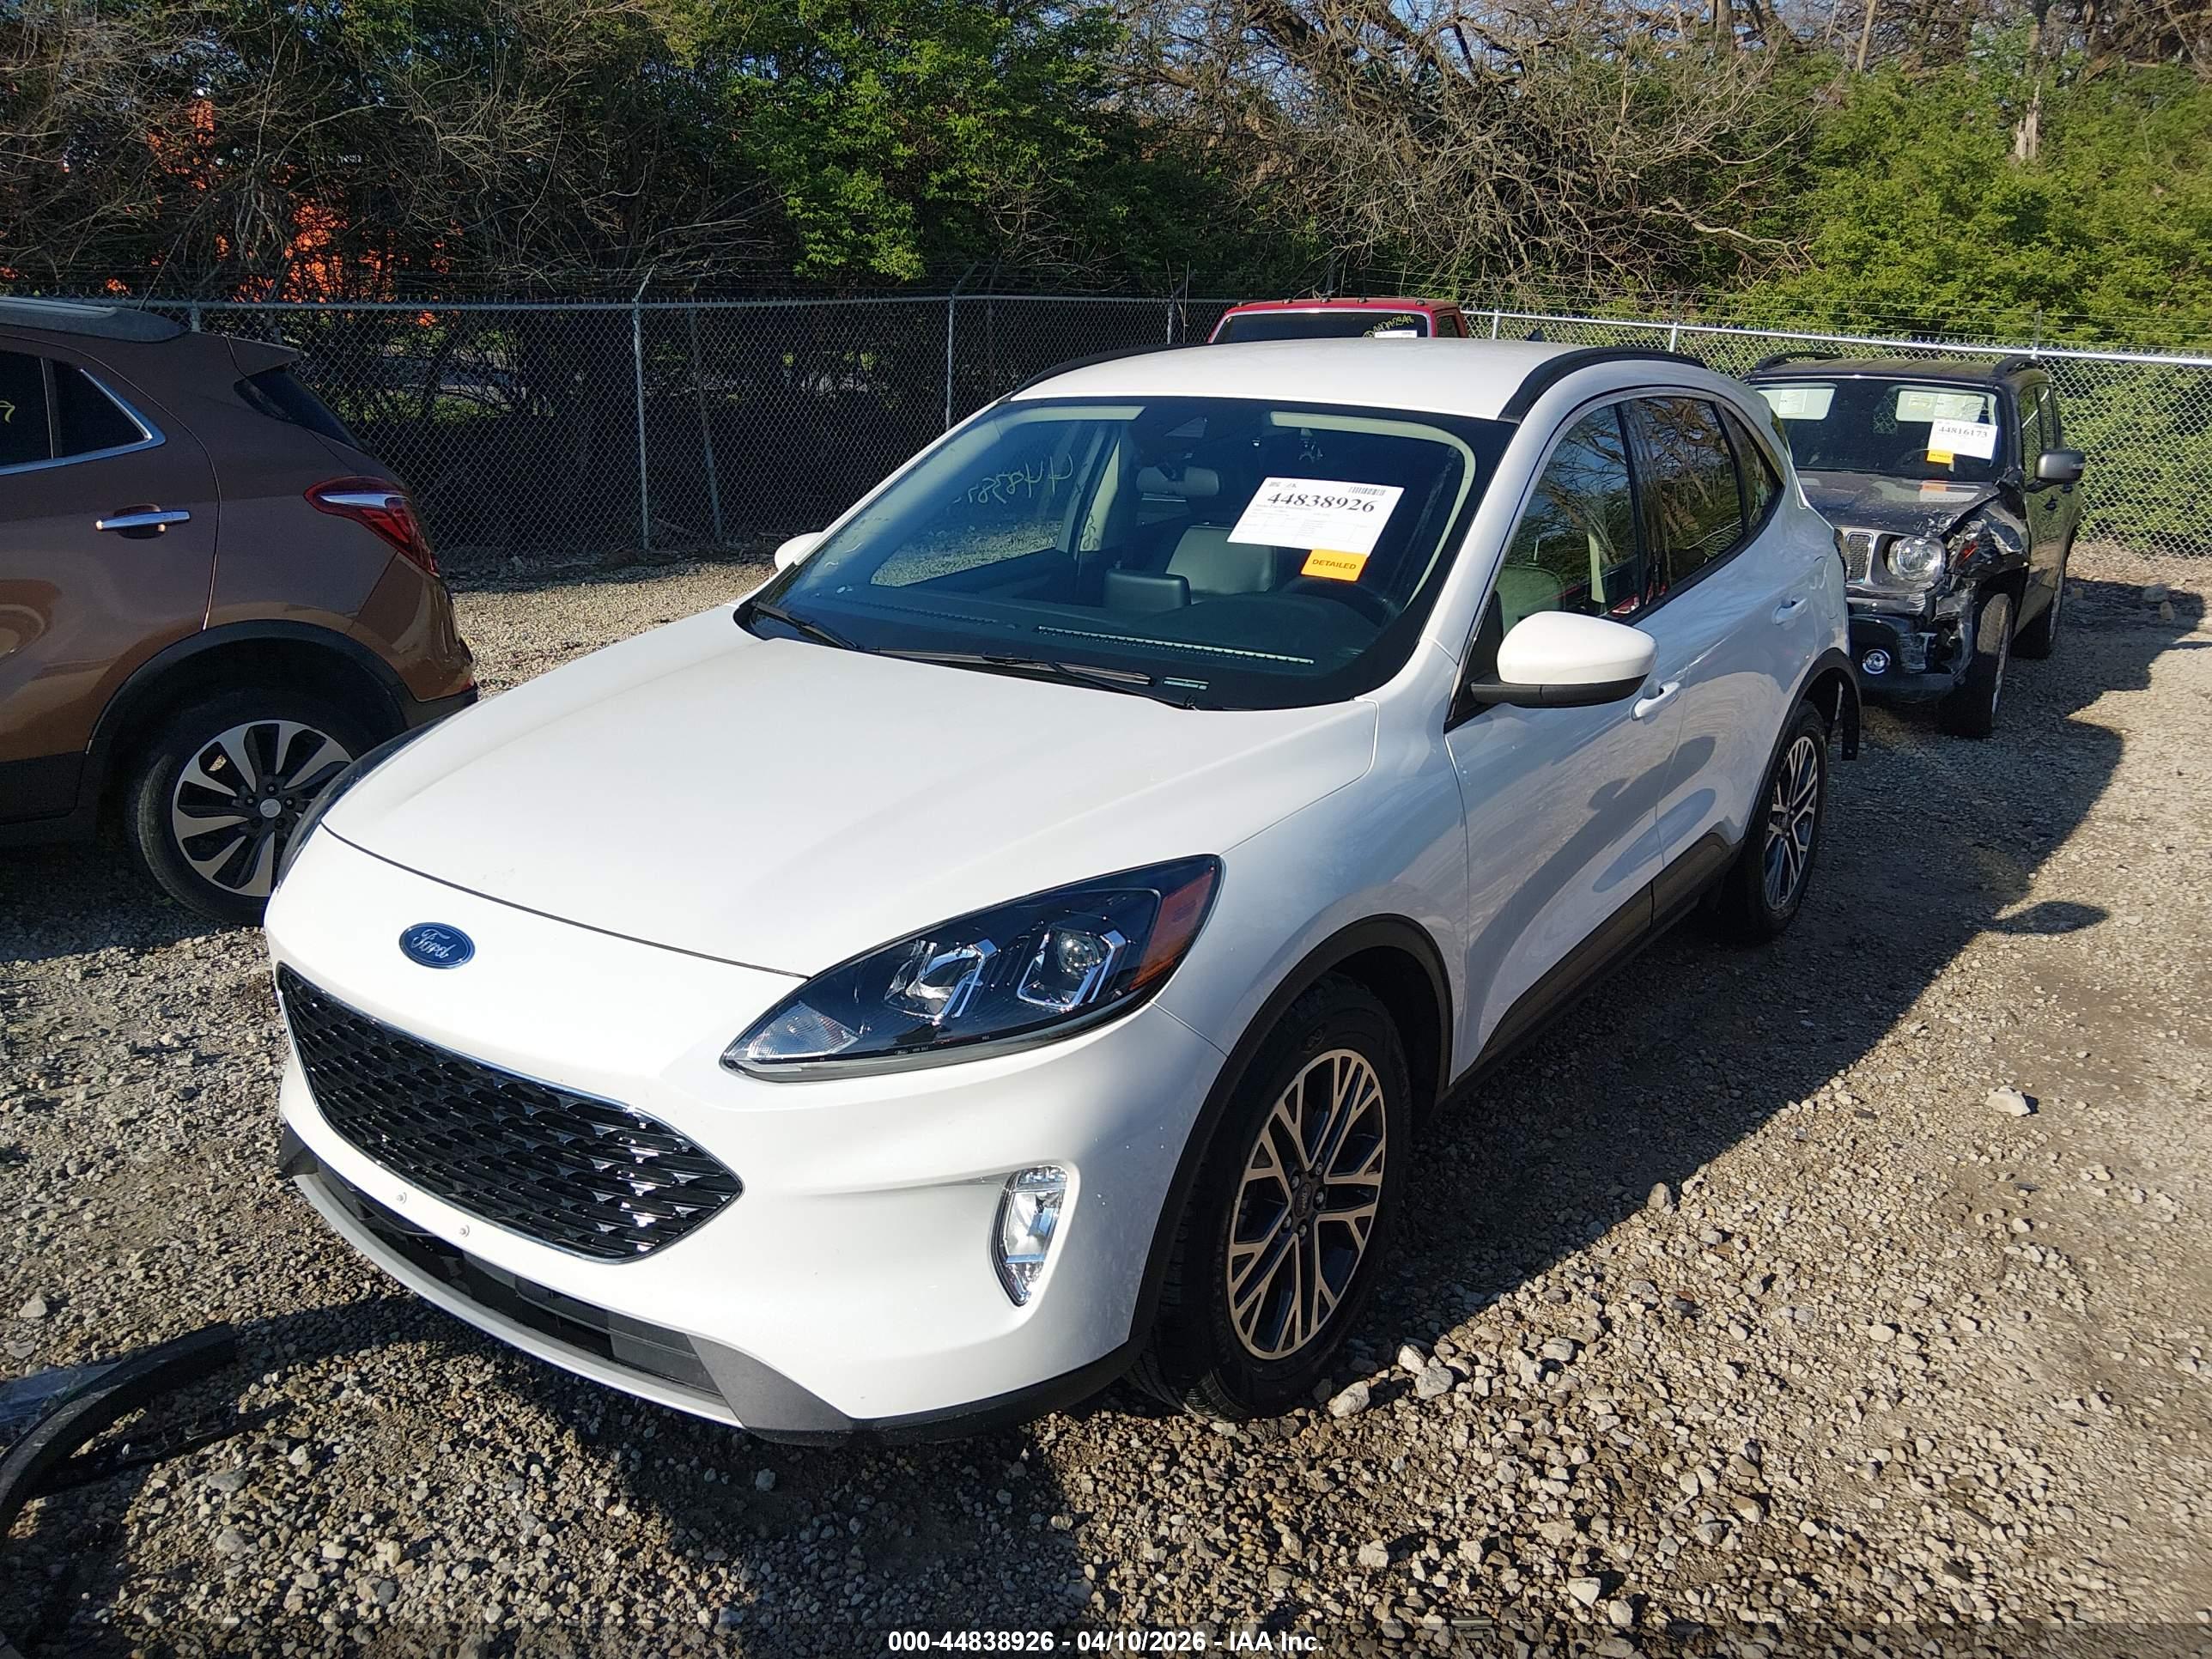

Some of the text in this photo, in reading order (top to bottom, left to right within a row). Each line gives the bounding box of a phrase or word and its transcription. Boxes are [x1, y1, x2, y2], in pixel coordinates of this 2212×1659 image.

[1939, 426, 1988, 438] 44816173
[1267, 492, 1378, 514] 44838926
[1312, 558, 1357, 570] DETAILED
